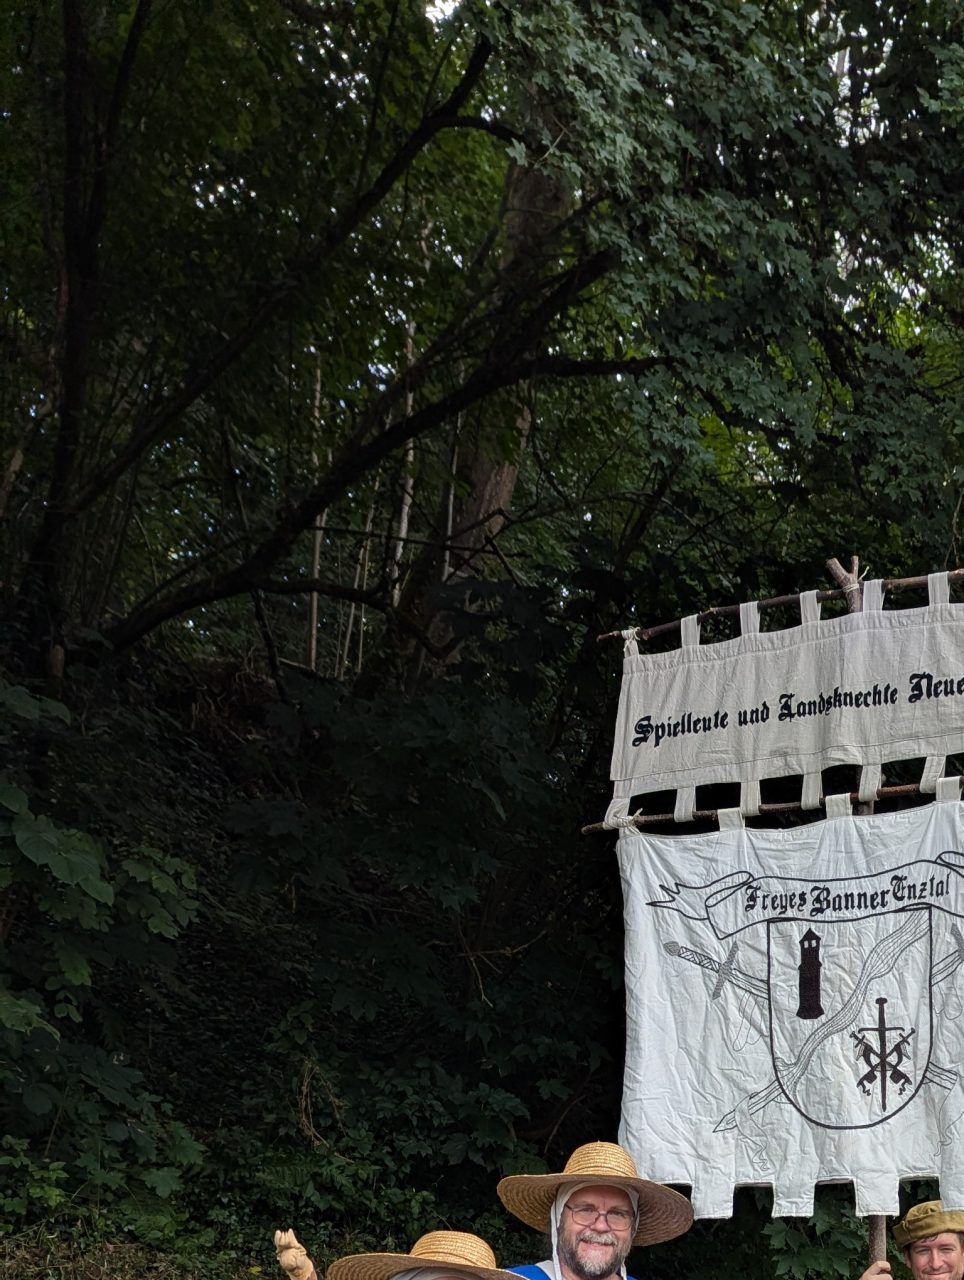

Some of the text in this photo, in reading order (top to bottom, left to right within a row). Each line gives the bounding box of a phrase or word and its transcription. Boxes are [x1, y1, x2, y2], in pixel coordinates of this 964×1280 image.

[631, 710, 729, 748] Spielleute
[738, 701, 770, 727] und
[778, 683, 898, 722] Landsknechte
[744, 873, 951, 917] Freyes Banner Enztal
